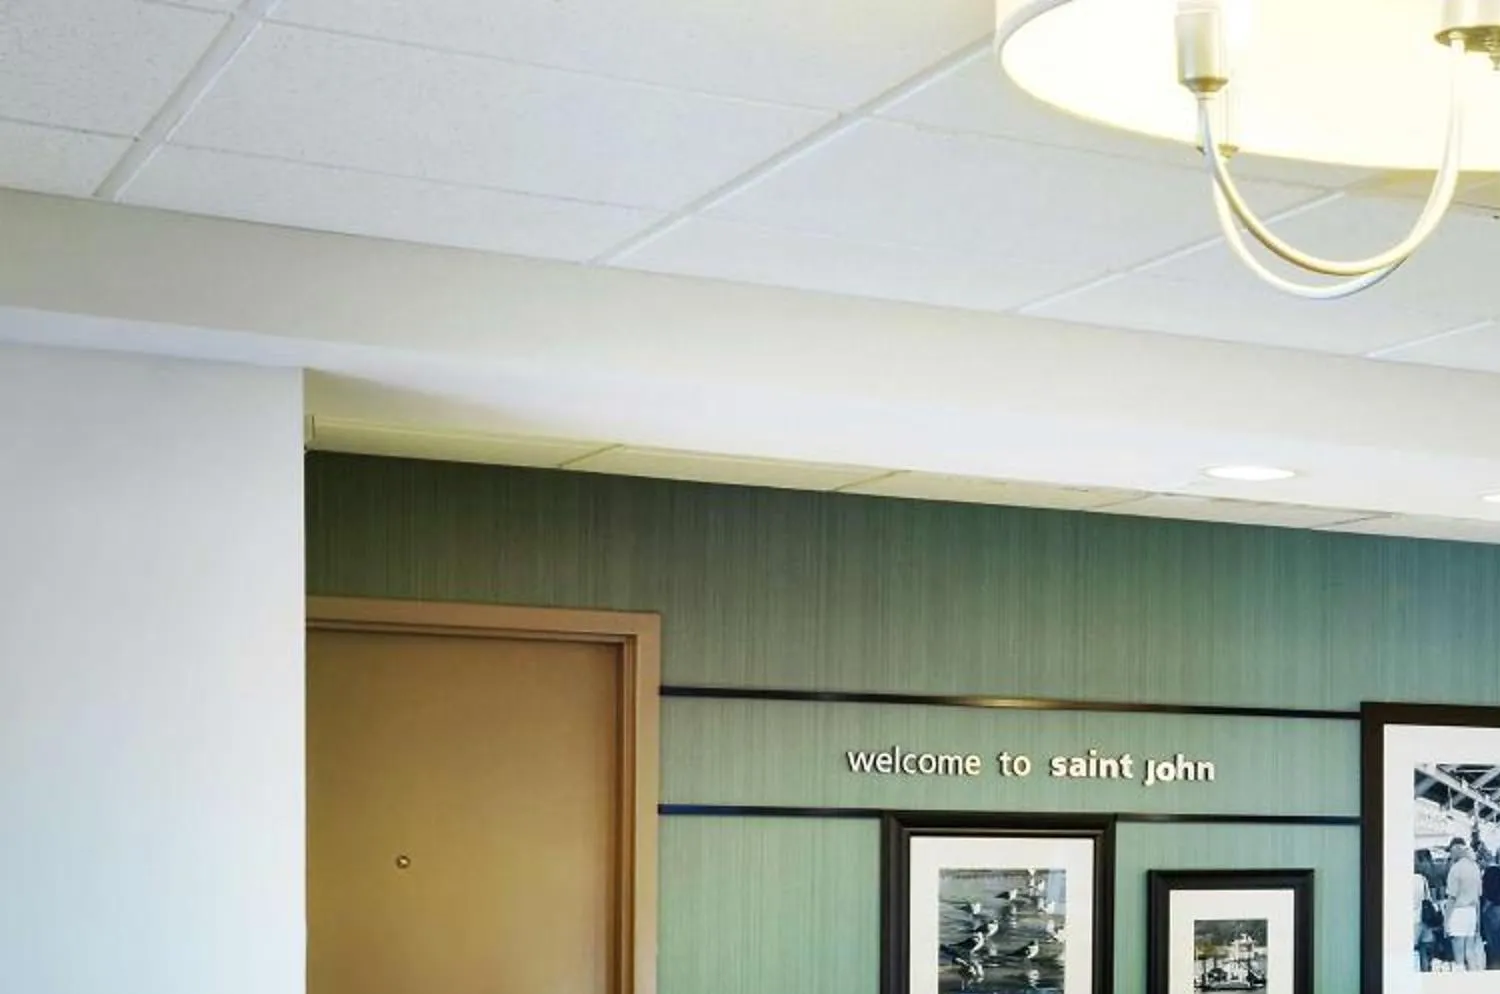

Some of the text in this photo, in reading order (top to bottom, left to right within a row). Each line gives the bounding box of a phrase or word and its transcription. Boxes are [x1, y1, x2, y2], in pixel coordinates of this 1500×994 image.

[847, 746, 1216, 787] welcome to saint john
